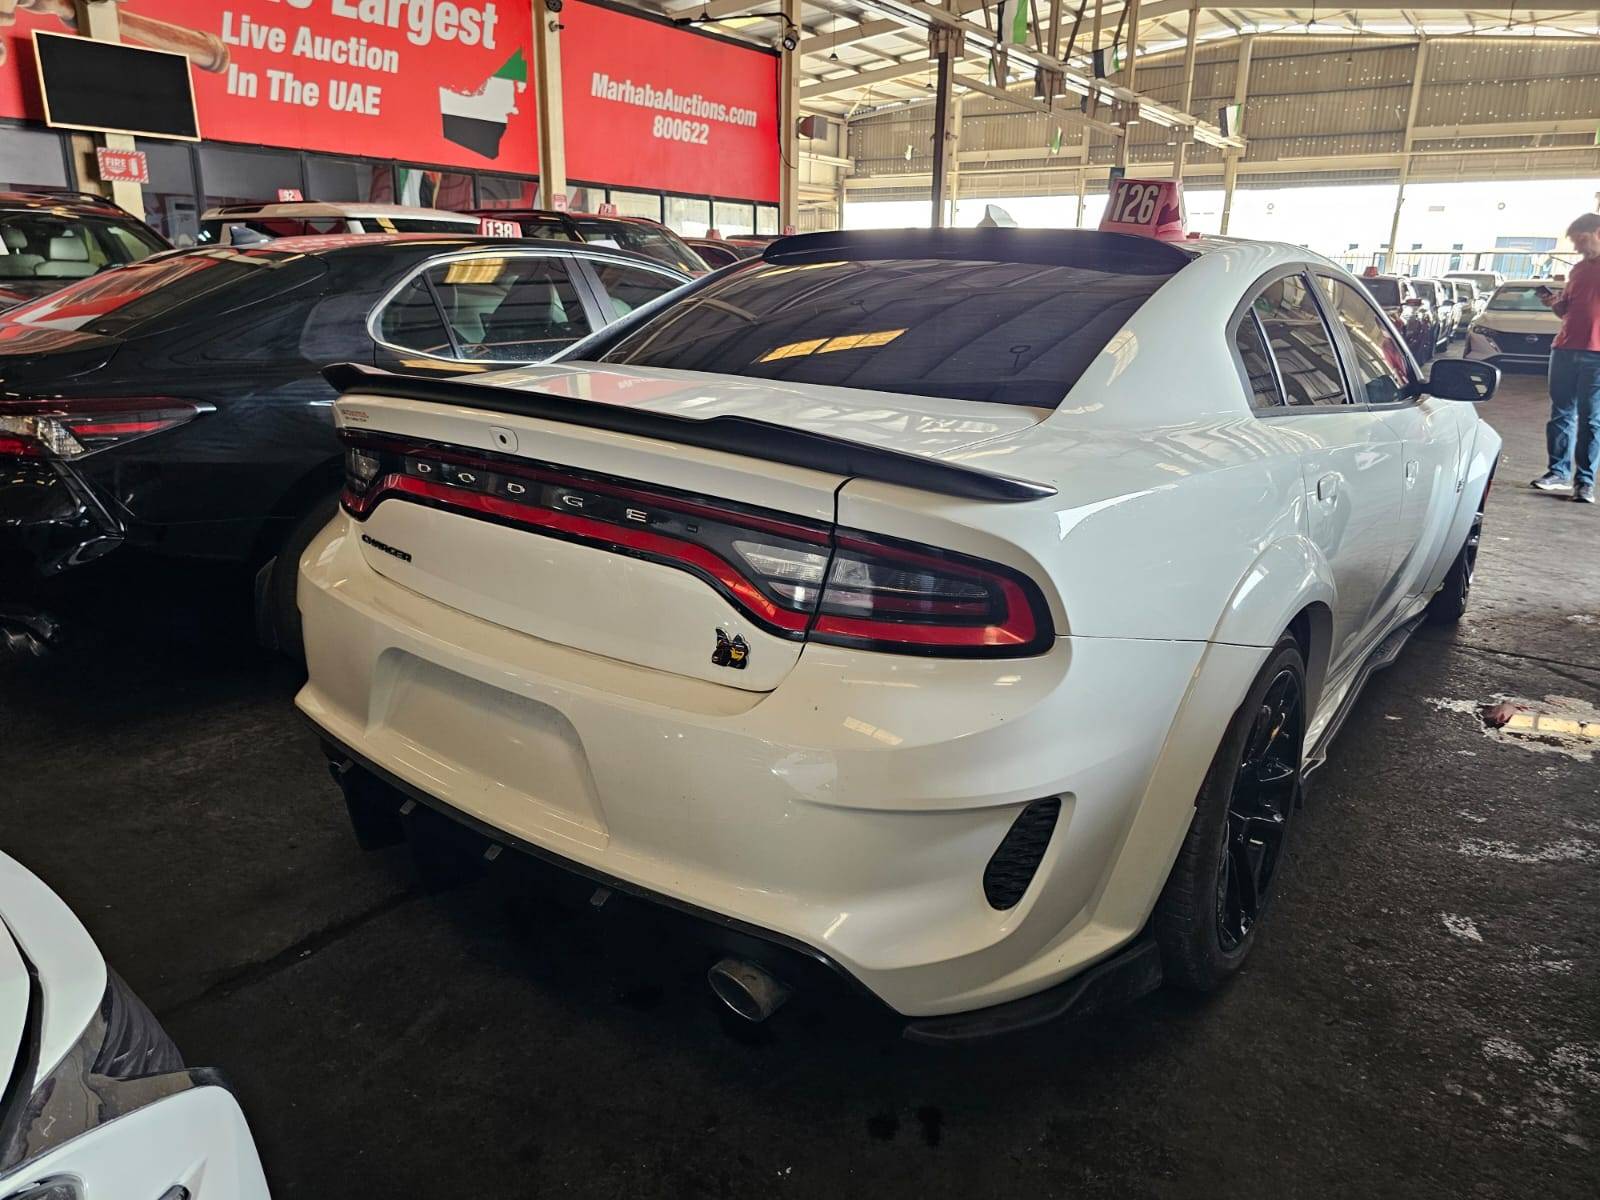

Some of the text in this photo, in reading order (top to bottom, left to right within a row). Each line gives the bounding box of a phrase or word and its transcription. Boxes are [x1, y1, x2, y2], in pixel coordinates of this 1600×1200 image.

[221, 11, 399, 74] Live Auction
[227, 63, 382, 116] In The UAE
[591, 72, 757, 128] MarhabaAuctions.com
[653, 115, 709, 145] 800622
[104, 156, 127, 169] FIRE
[1112, 183, 1159, 224] 126
[486, 222, 513, 238] 138
[417, 462, 648, 523] DODGE
[361, 534, 412, 563] CHARGER
